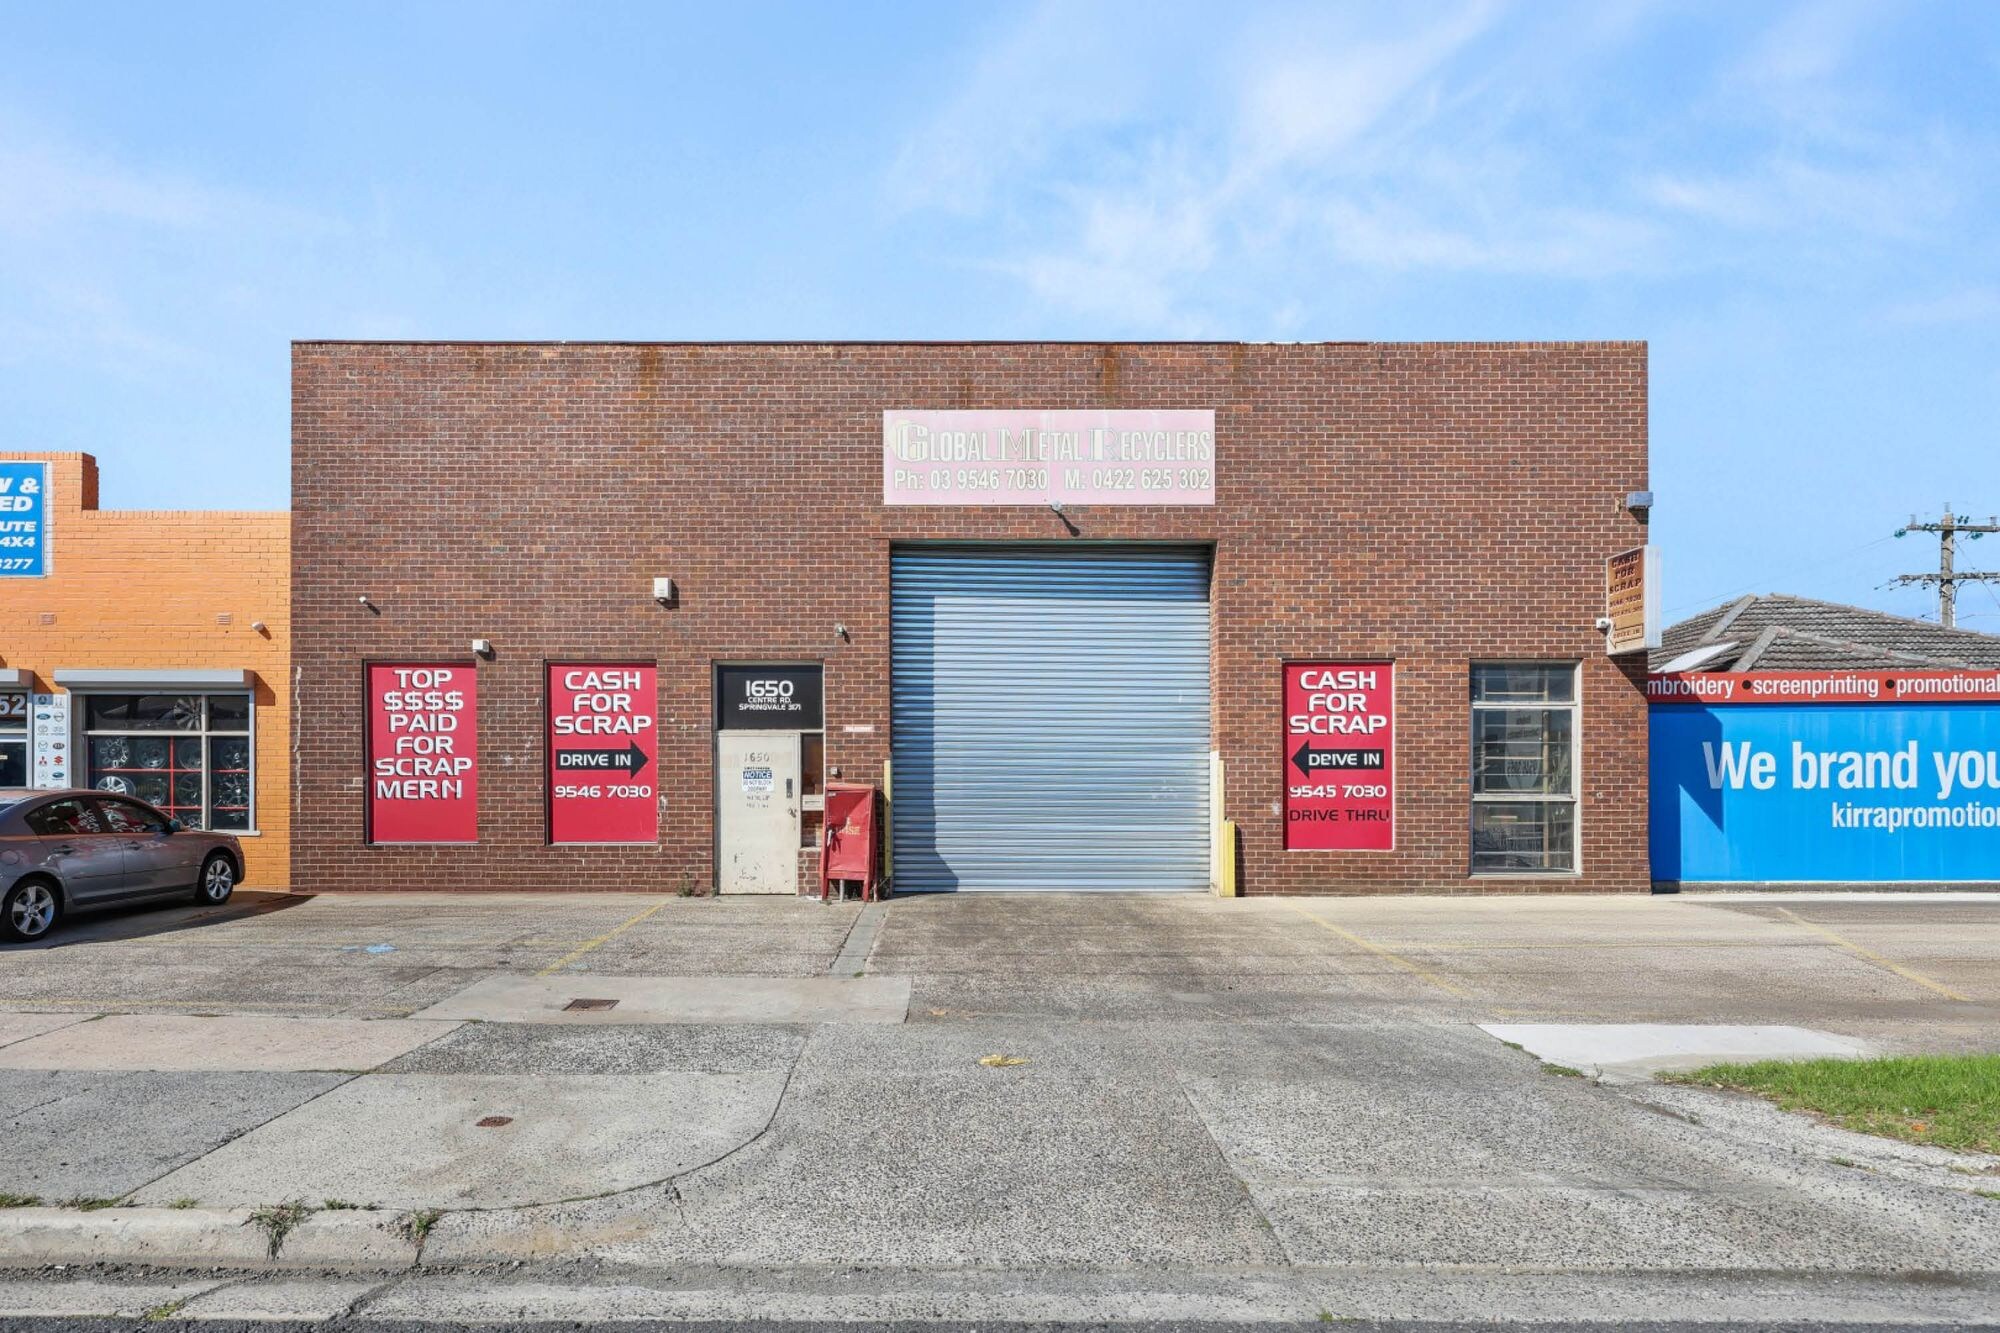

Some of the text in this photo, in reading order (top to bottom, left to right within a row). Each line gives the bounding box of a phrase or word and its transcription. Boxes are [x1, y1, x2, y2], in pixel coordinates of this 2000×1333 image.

[894, 469, 1211, 490] Ph: 03 9546 7030 M: 0422 625 302
[0, 558, 34, 570] 277
[1615, 565, 1636, 581] FOR
[1609, 577, 1643, 596] SCRAP
[393, 669, 453, 689] TOP
[564, 671, 641, 691] CASH
[745, 680, 794, 697] 1650
[1299, 671, 1377, 691] CASH
[1647, 673, 2000, 699] mbroidery screenprinting promotional
[383, 690, 464, 712] $$$$
[573, 693, 632, 713] FOR
[738, 703, 786, 711] SPRINGVALE
[747, 696, 778, 704] CENTRE
[1308, 693, 1367, 713] FOR
[389, 713, 458, 733] PAID
[554, 715, 652, 735] SCRAP
[1289, 715, 1388, 735] SCRAP
[395, 735, 454, 755] FOR
[374, 757, 473, 777] SCRAP
[559, 753, 632, 767] DRIVE IN
[1363, 753, 1380, 766] IN
[1703, 741, 1776, 789] We
[1791, 740, 1918, 789] brand
[743, 770, 772, 779] NOTICE
[555, 785, 651, 798] 9546 7030
[1341, 785, 1387, 798] 7030
[1289, 809, 1390, 822] DRIVE THRU
[1831, 802, 2000, 833] kirrapromotio
